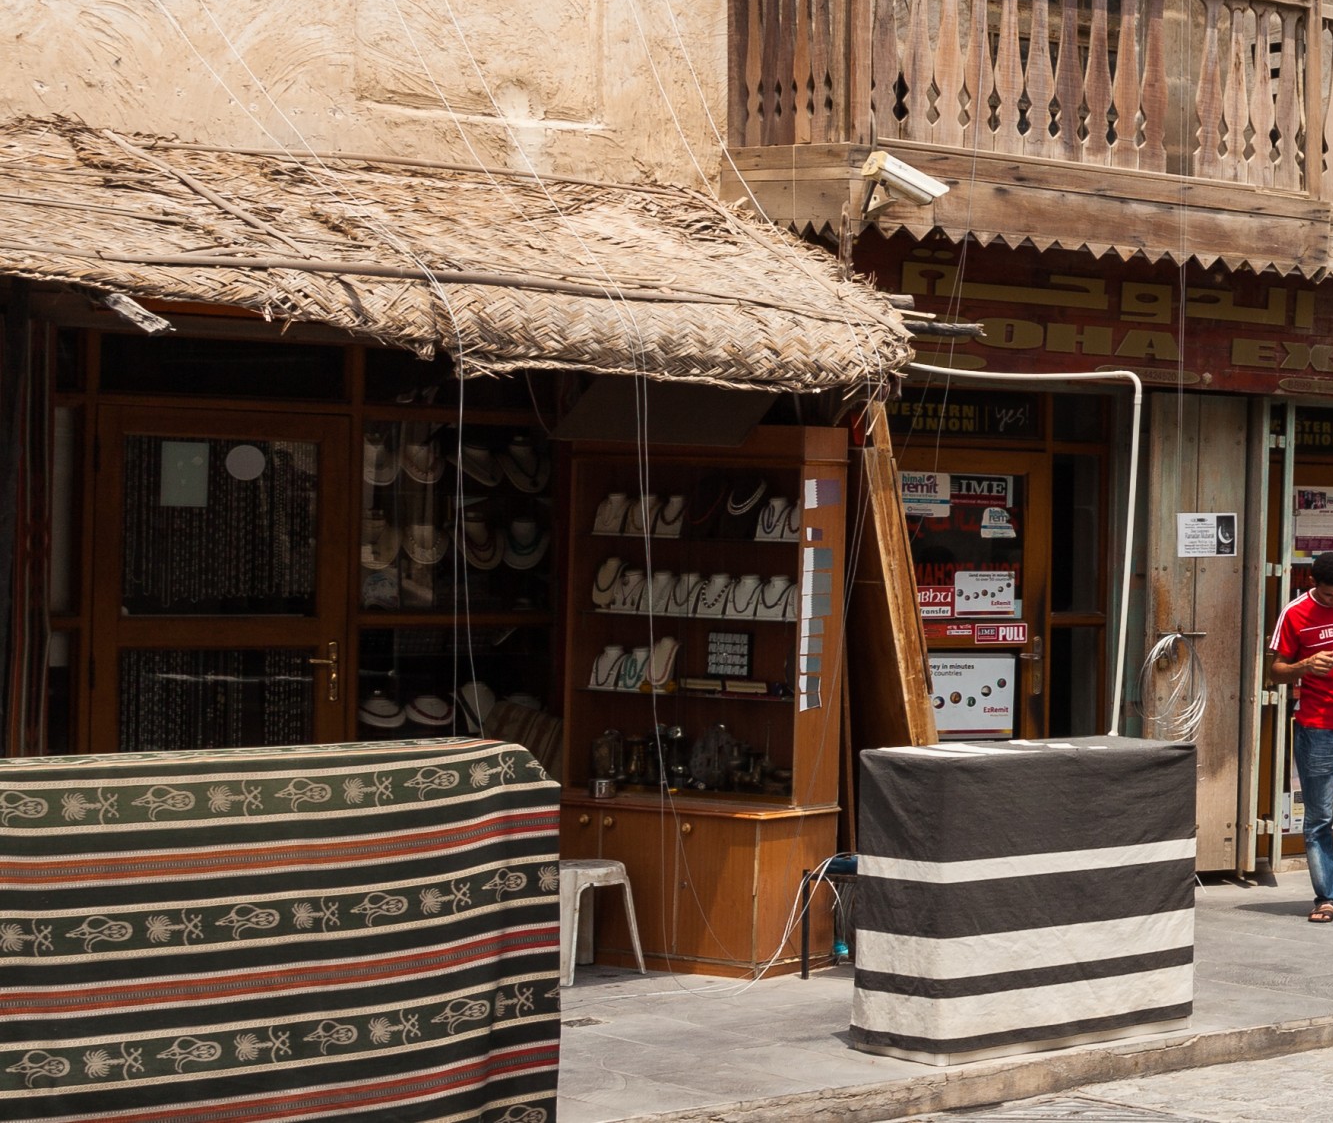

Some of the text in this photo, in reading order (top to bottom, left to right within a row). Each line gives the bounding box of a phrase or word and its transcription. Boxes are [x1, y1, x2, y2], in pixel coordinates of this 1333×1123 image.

[901, 247, 1316, 329] الدوحة
[886, 401, 975, 418] WESTERN
[912, 416, 976, 432] UNION
[902, 481, 938, 494] remit
[960, 479, 1006, 496] IME
[998, 626, 1025, 641] PULL
